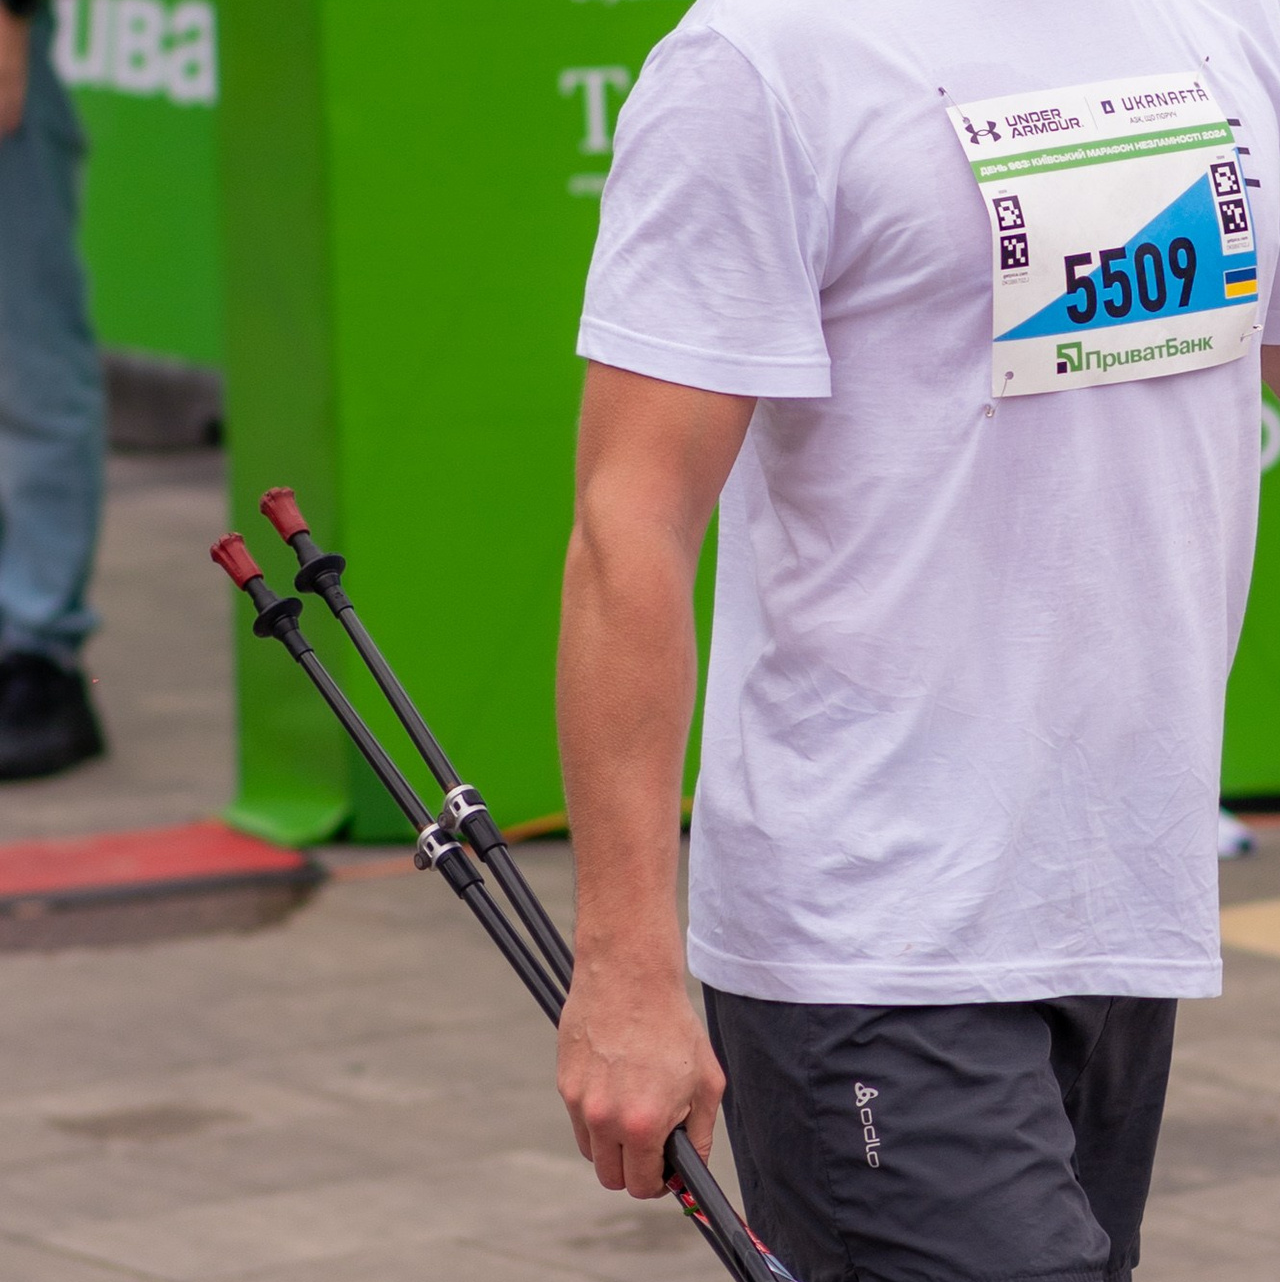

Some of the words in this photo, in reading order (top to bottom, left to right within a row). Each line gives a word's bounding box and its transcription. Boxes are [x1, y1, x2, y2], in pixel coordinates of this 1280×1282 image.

[1121, 88, 1209, 112] UKRNAFTA
[1004, 108, 1062, 128] UNDER
[1011, 117, 1081, 140] ARMOUR
[1031, 149, 1086, 167] КИЇВСЬКИЙ
[1087, 142, 1134, 159] МАРАФОН
[1135, 133, 1202, 151] НЕЗЛАМНОСТІ
[1202, 128, 1227, 141] 2024
[1064, 237, 1197, 325] 5509
[1085, 335, 1214, 373] ПриватБанк
